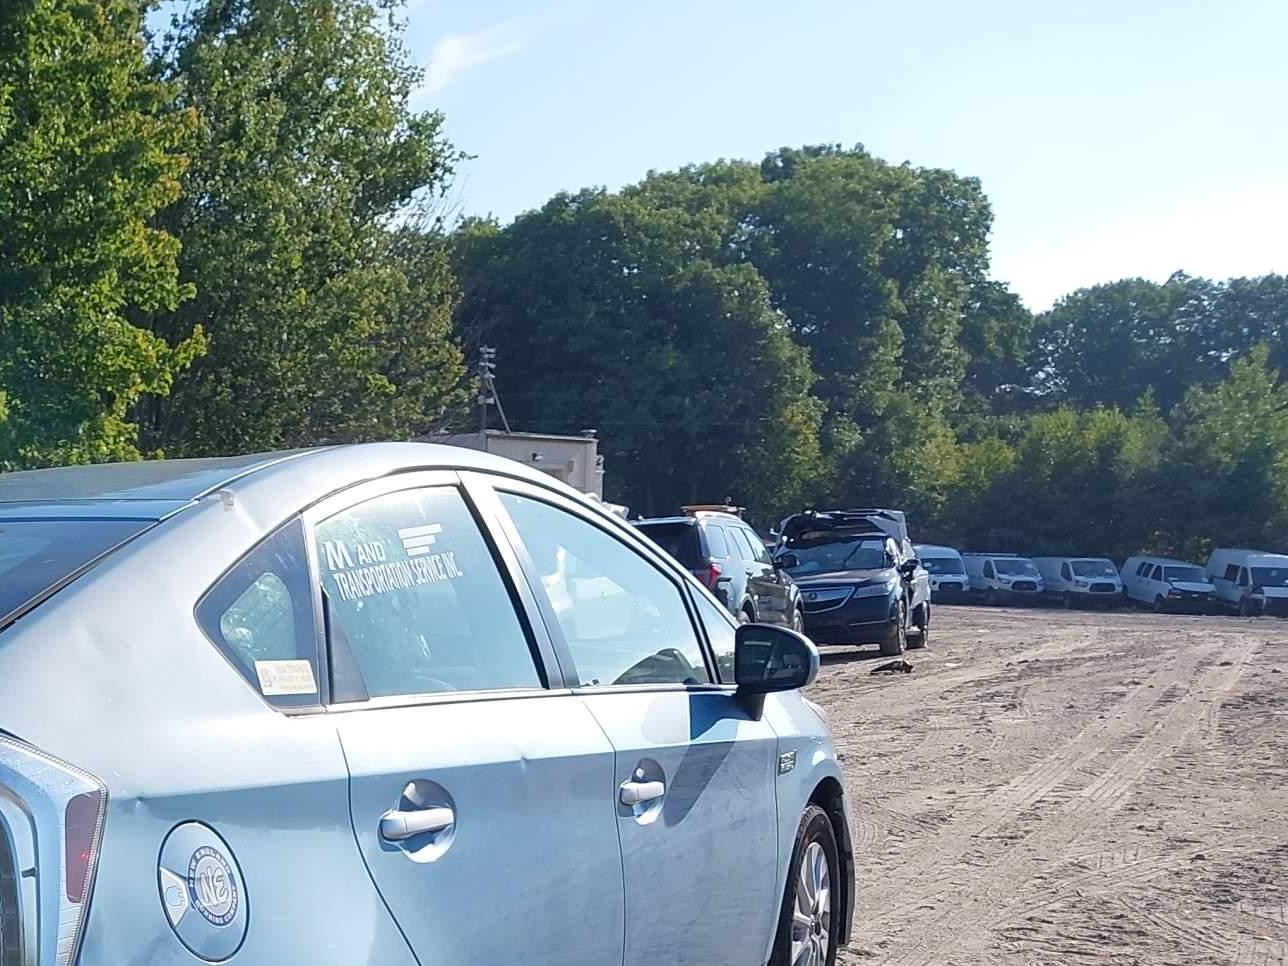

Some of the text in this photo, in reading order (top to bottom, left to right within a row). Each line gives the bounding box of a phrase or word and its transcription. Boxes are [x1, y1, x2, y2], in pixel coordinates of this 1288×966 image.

[323, 539, 387, 571] M AND
[332, 551, 464, 601] TRANSPORTATION SERVICE INC.
